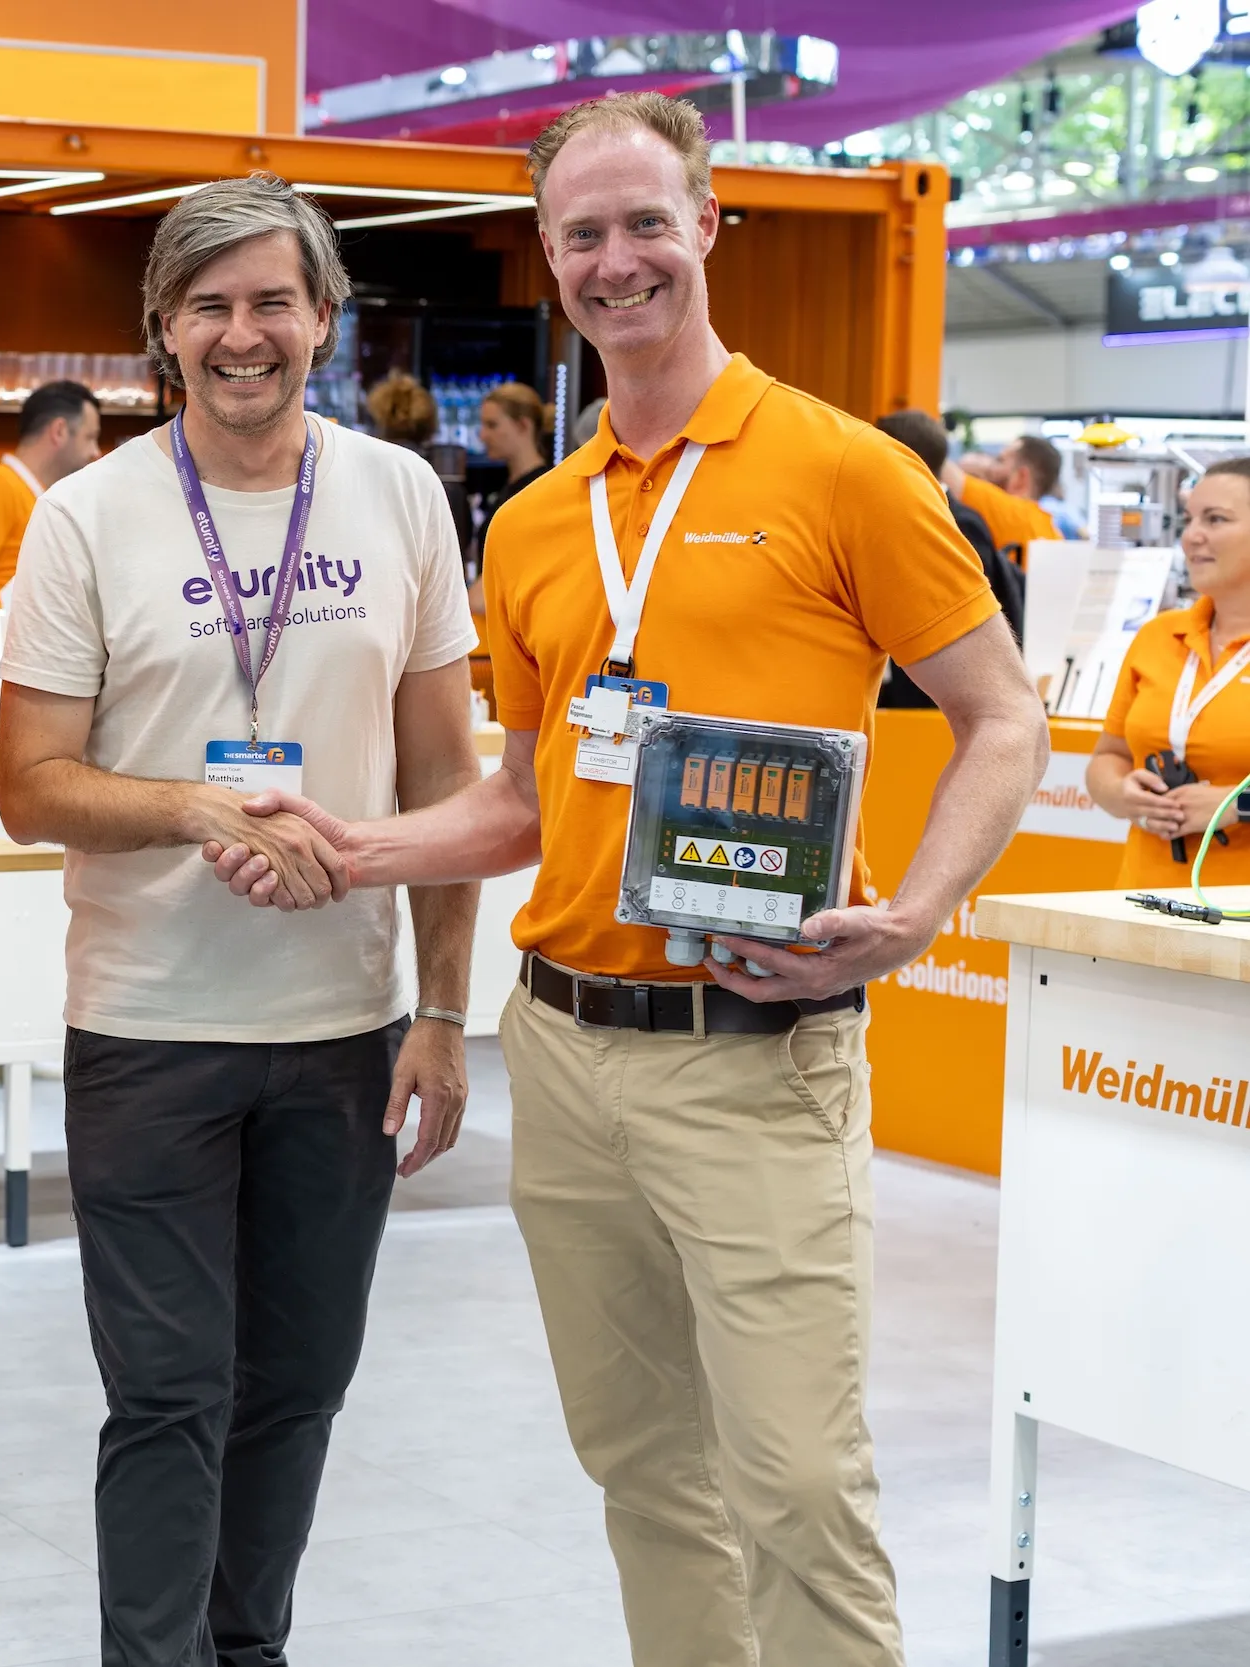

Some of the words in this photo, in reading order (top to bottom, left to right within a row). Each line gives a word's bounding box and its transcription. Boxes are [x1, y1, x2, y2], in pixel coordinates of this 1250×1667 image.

[302, 444, 317, 494] eturnity
[196, 511, 220, 562] eturnity
[684, 531, 750, 544] Weidmüller
[216, 570, 232, 600] Software
[277, 584, 290, 615] Software
[284, 552, 297, 584] Solutions
[190, 615, 271, 638] Softare
[580, 741, 600, 750] Germany
[589, 756, 617, 765] EXHIBITOR
[1062, 1045, 1250, 1129] Weidmül
